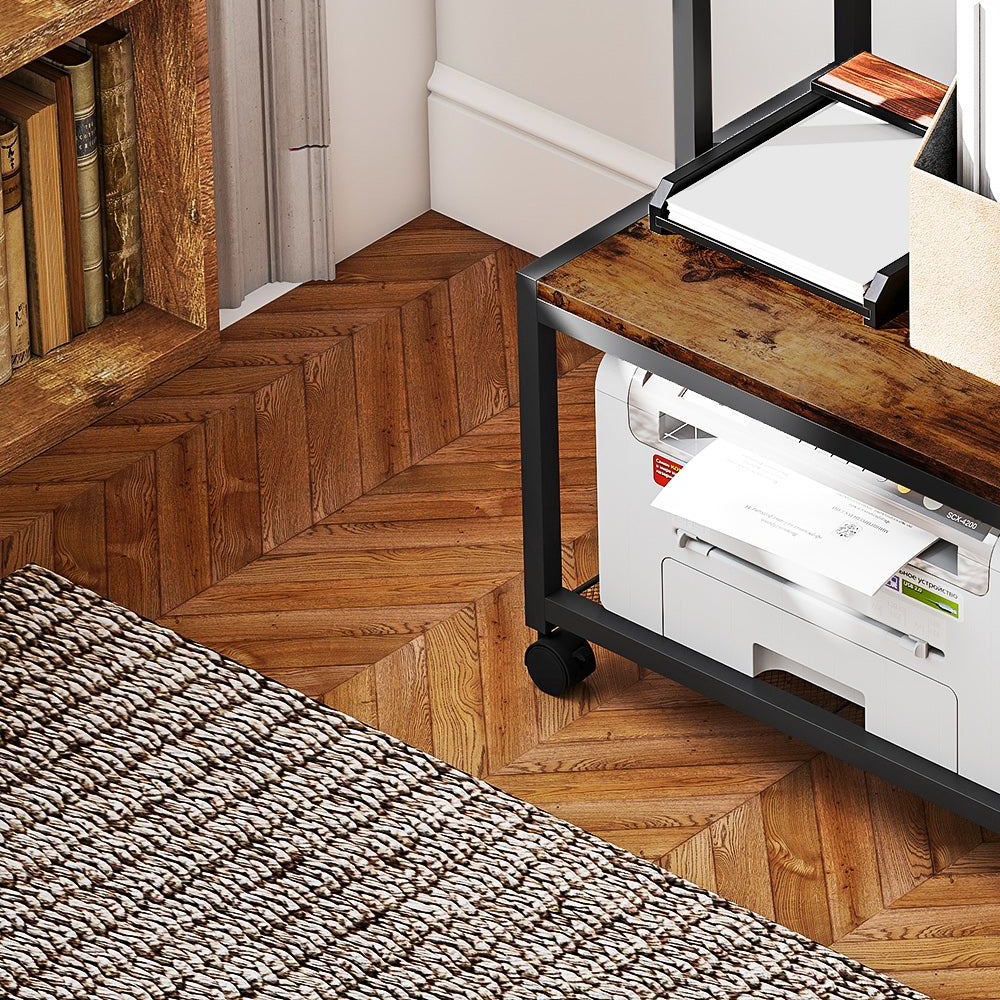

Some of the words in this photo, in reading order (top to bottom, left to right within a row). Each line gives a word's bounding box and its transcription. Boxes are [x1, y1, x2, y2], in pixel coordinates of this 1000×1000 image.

[946, 511, 977, 530] SCX-4200
[903, 581, 914, 590] USB
[917, 577, 958, 600] устройство
